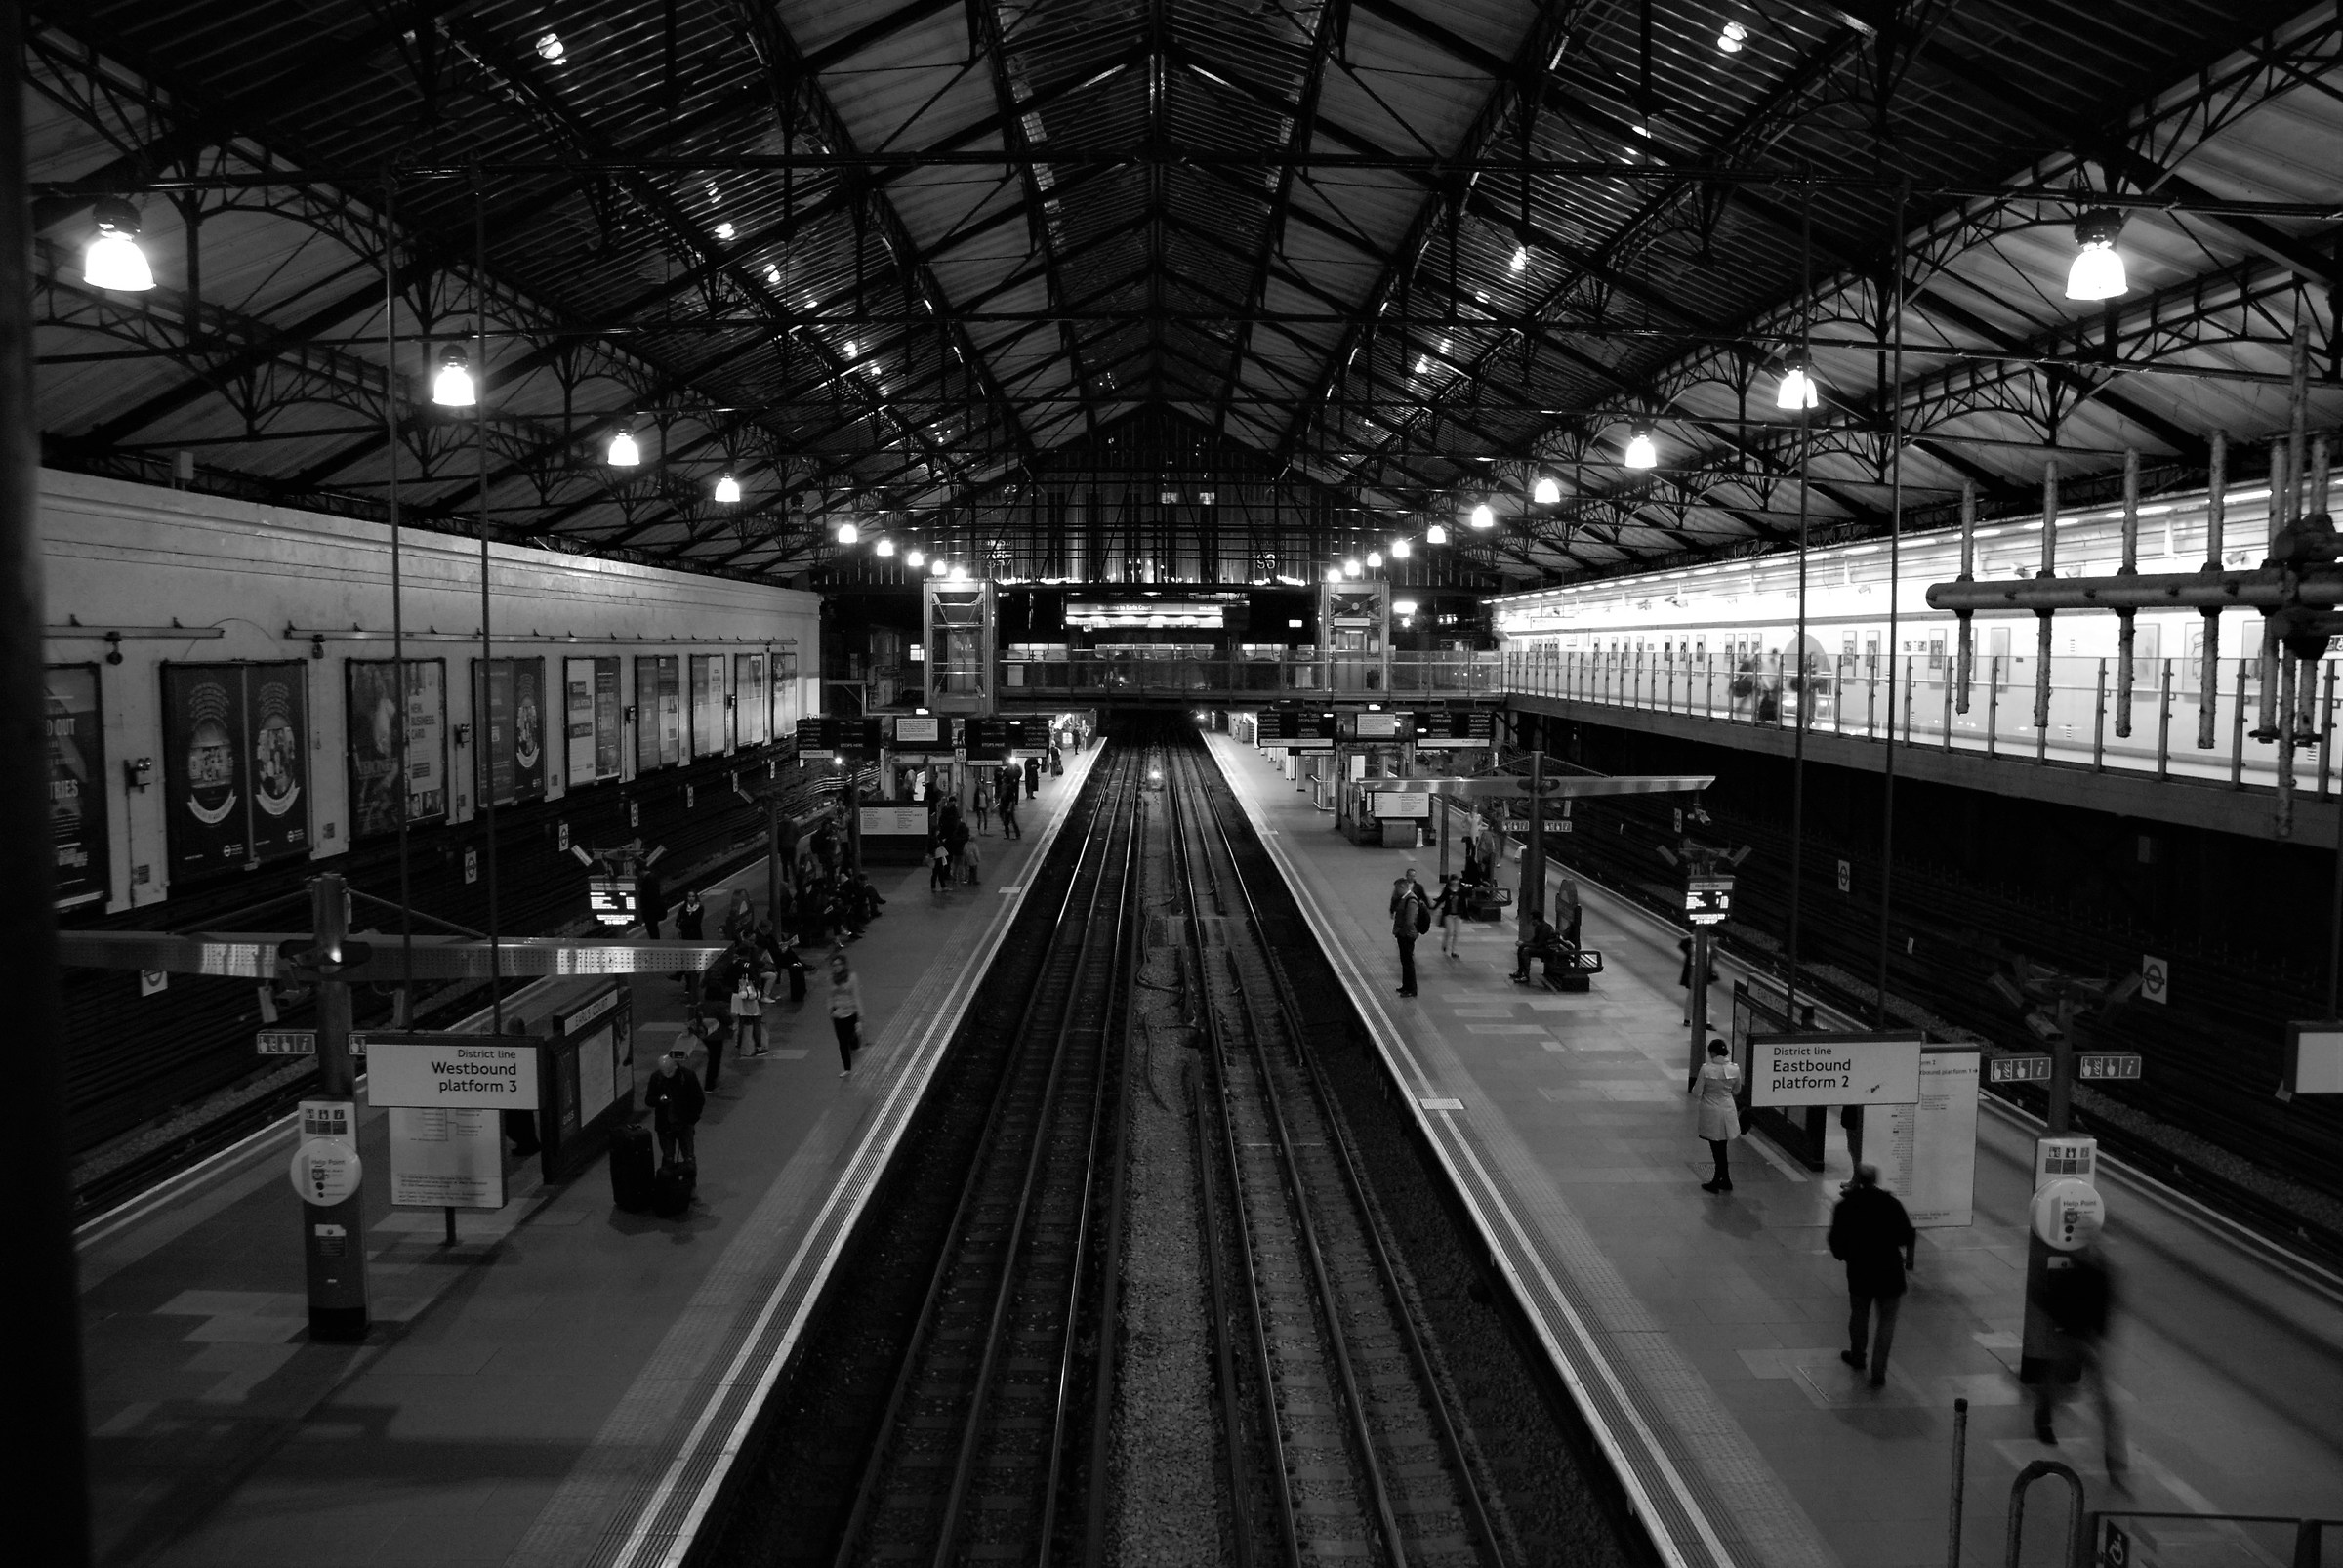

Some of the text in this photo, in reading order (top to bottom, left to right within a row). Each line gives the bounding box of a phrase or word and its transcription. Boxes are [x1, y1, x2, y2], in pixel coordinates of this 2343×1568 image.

[458, 1049, 516, 1059] District line
[1773, 1046, 1832, 1056] District line
[431, 1061, 517, 1076] Westbound
[1772, 1058, 1851, 1073] Eastbound
[439, 1078, 517, 1094] platform 3
[1772, 1074, 1850, 1092] platform 2
